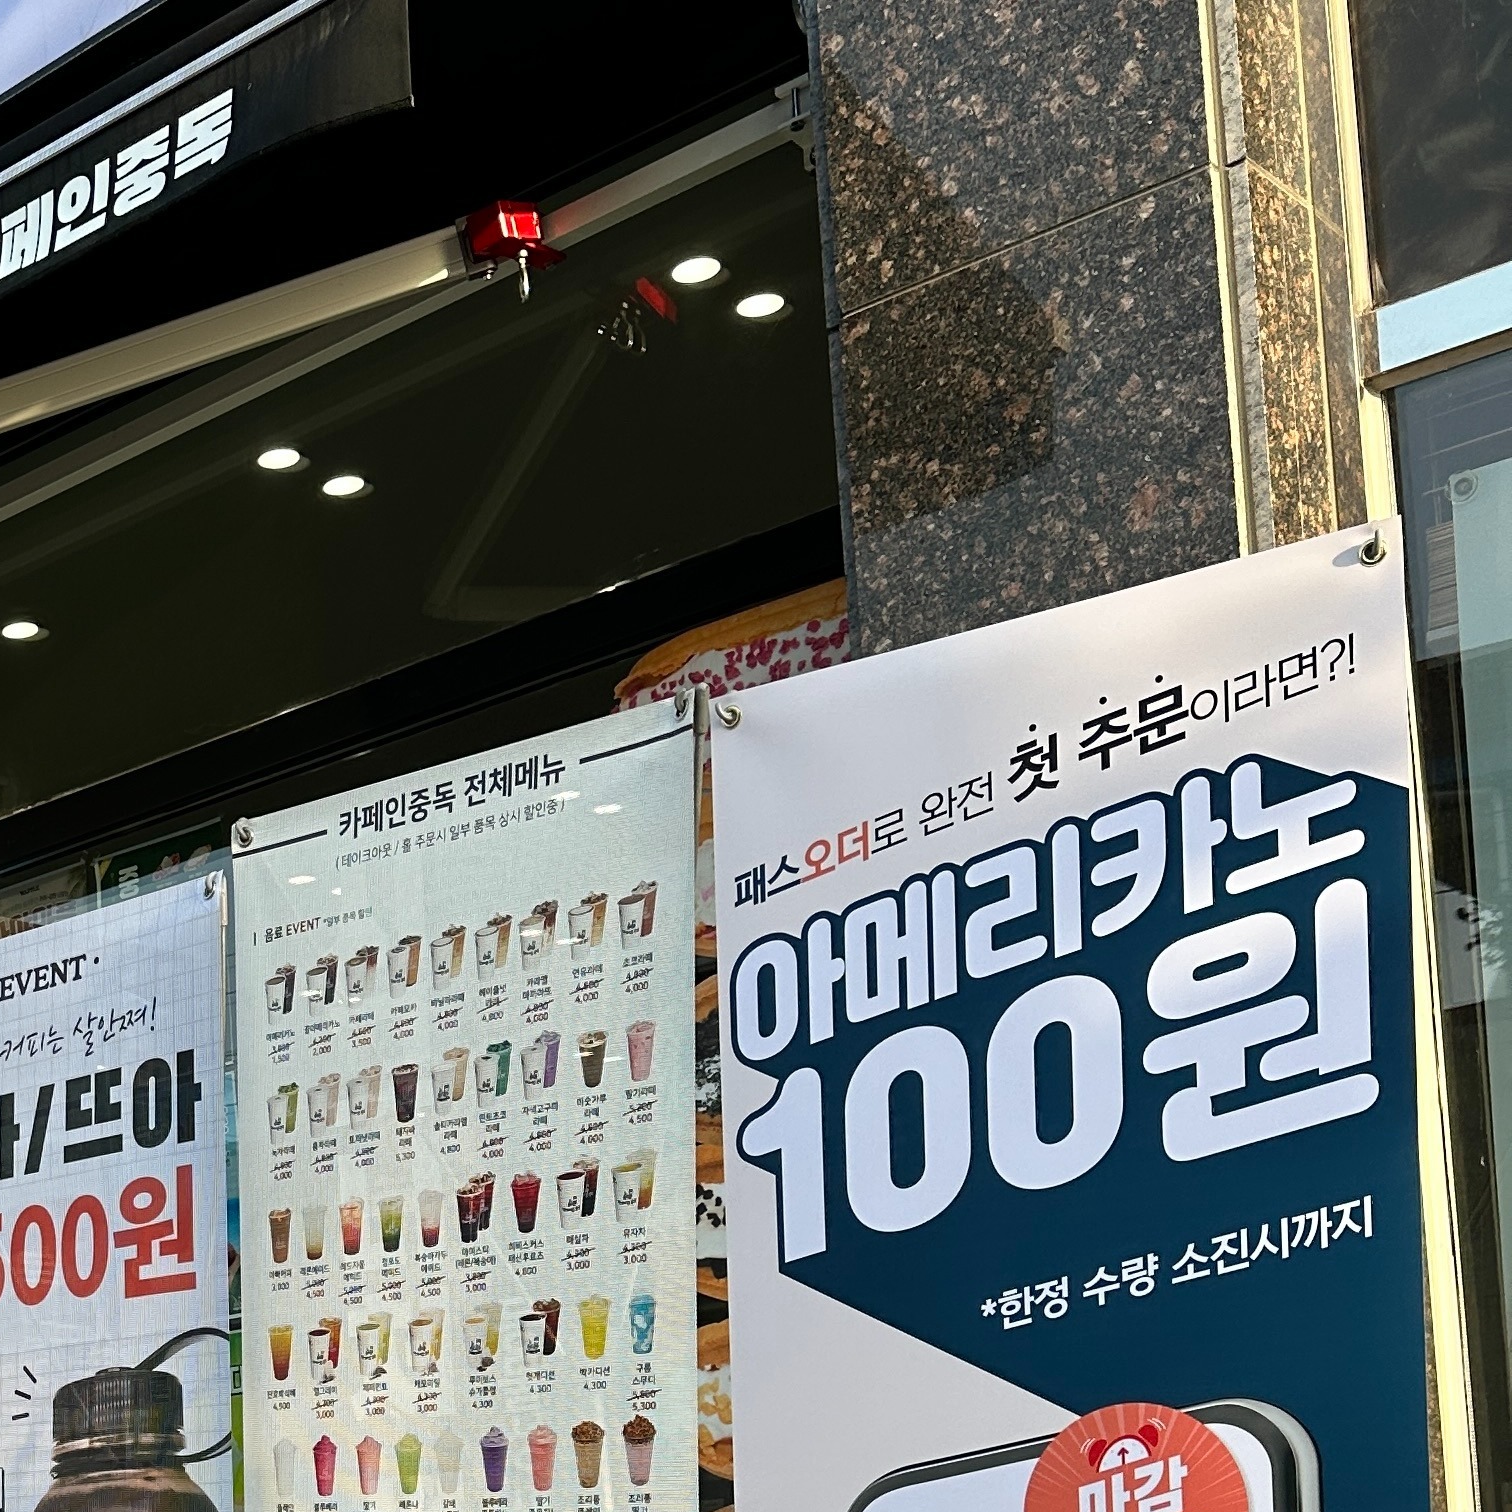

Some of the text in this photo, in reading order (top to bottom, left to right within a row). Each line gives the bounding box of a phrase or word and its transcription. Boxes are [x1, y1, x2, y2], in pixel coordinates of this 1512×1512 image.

[339, 754, 565, 839] 카페인중독 전체메뉴
[735, 634, 1357, 908] 패스오더로 완전 첫 주문이라면?!
[286, 917, 320, 937] EVENT
[735, 762, 1366, 1061] 아메리카노
[0, 955, 87, 1002] EVENT
[0, 1025, 63, 1061] 커피는
[743, 878, 1379, 1262] 100원
[1082, 1253, 1157, 1306] 수량
[1171, 1195, 1374, 1282] 소진시까지
